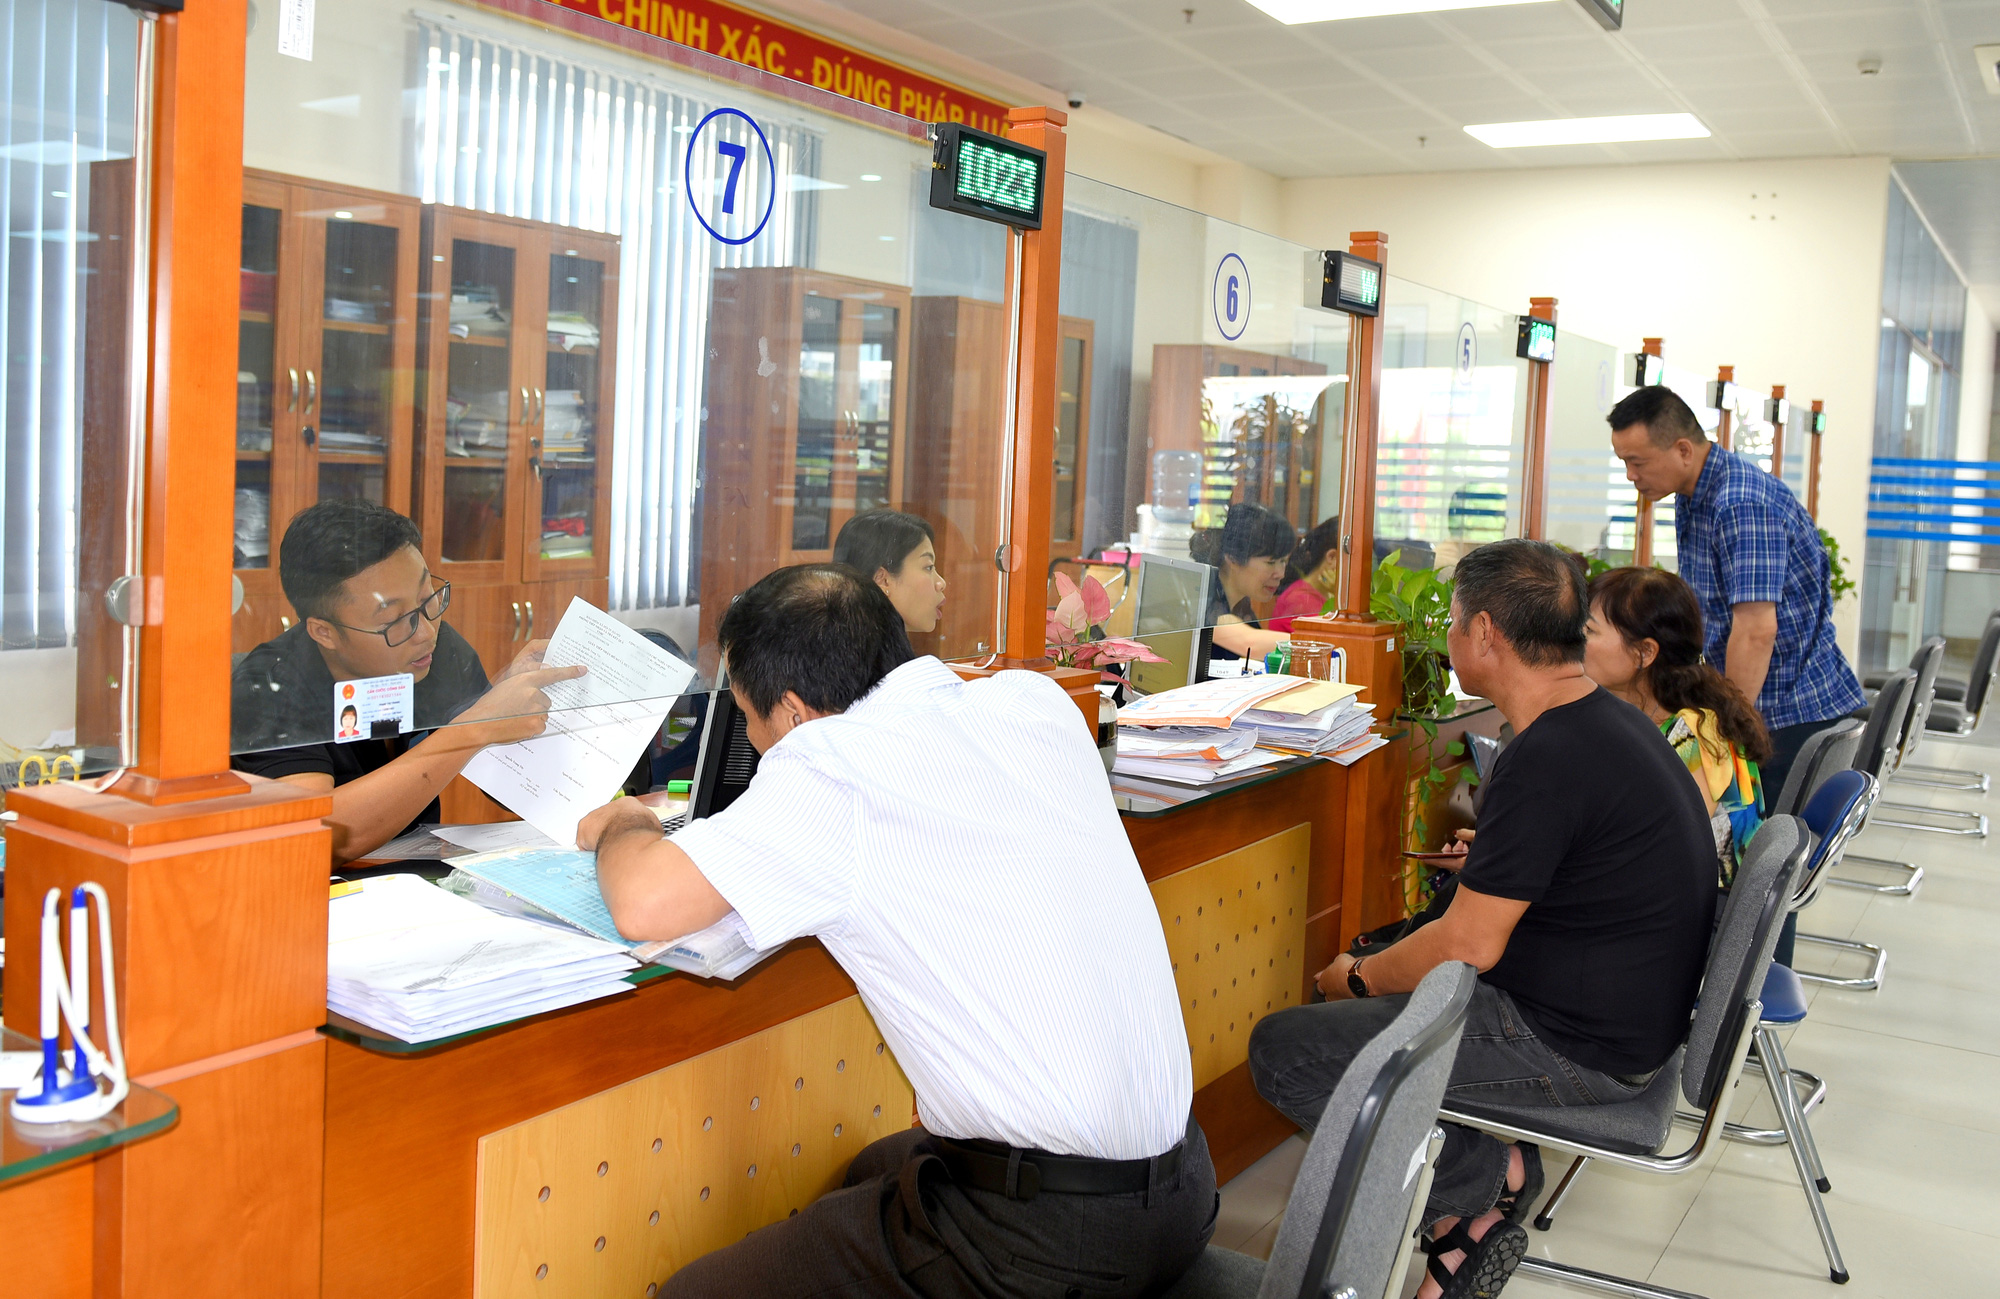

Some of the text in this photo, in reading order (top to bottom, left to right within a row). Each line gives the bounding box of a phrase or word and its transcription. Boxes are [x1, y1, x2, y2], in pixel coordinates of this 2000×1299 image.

[718, 24, 786, 75] XÁC
[811, 56, 892, 111] ĐÚNG
[900, 86, 965, 124] PHÁP
[718, 141, 746, 215] 7
[1226, 275, 1239, 323] 6
[1463, 338, 1470, 371] 5
